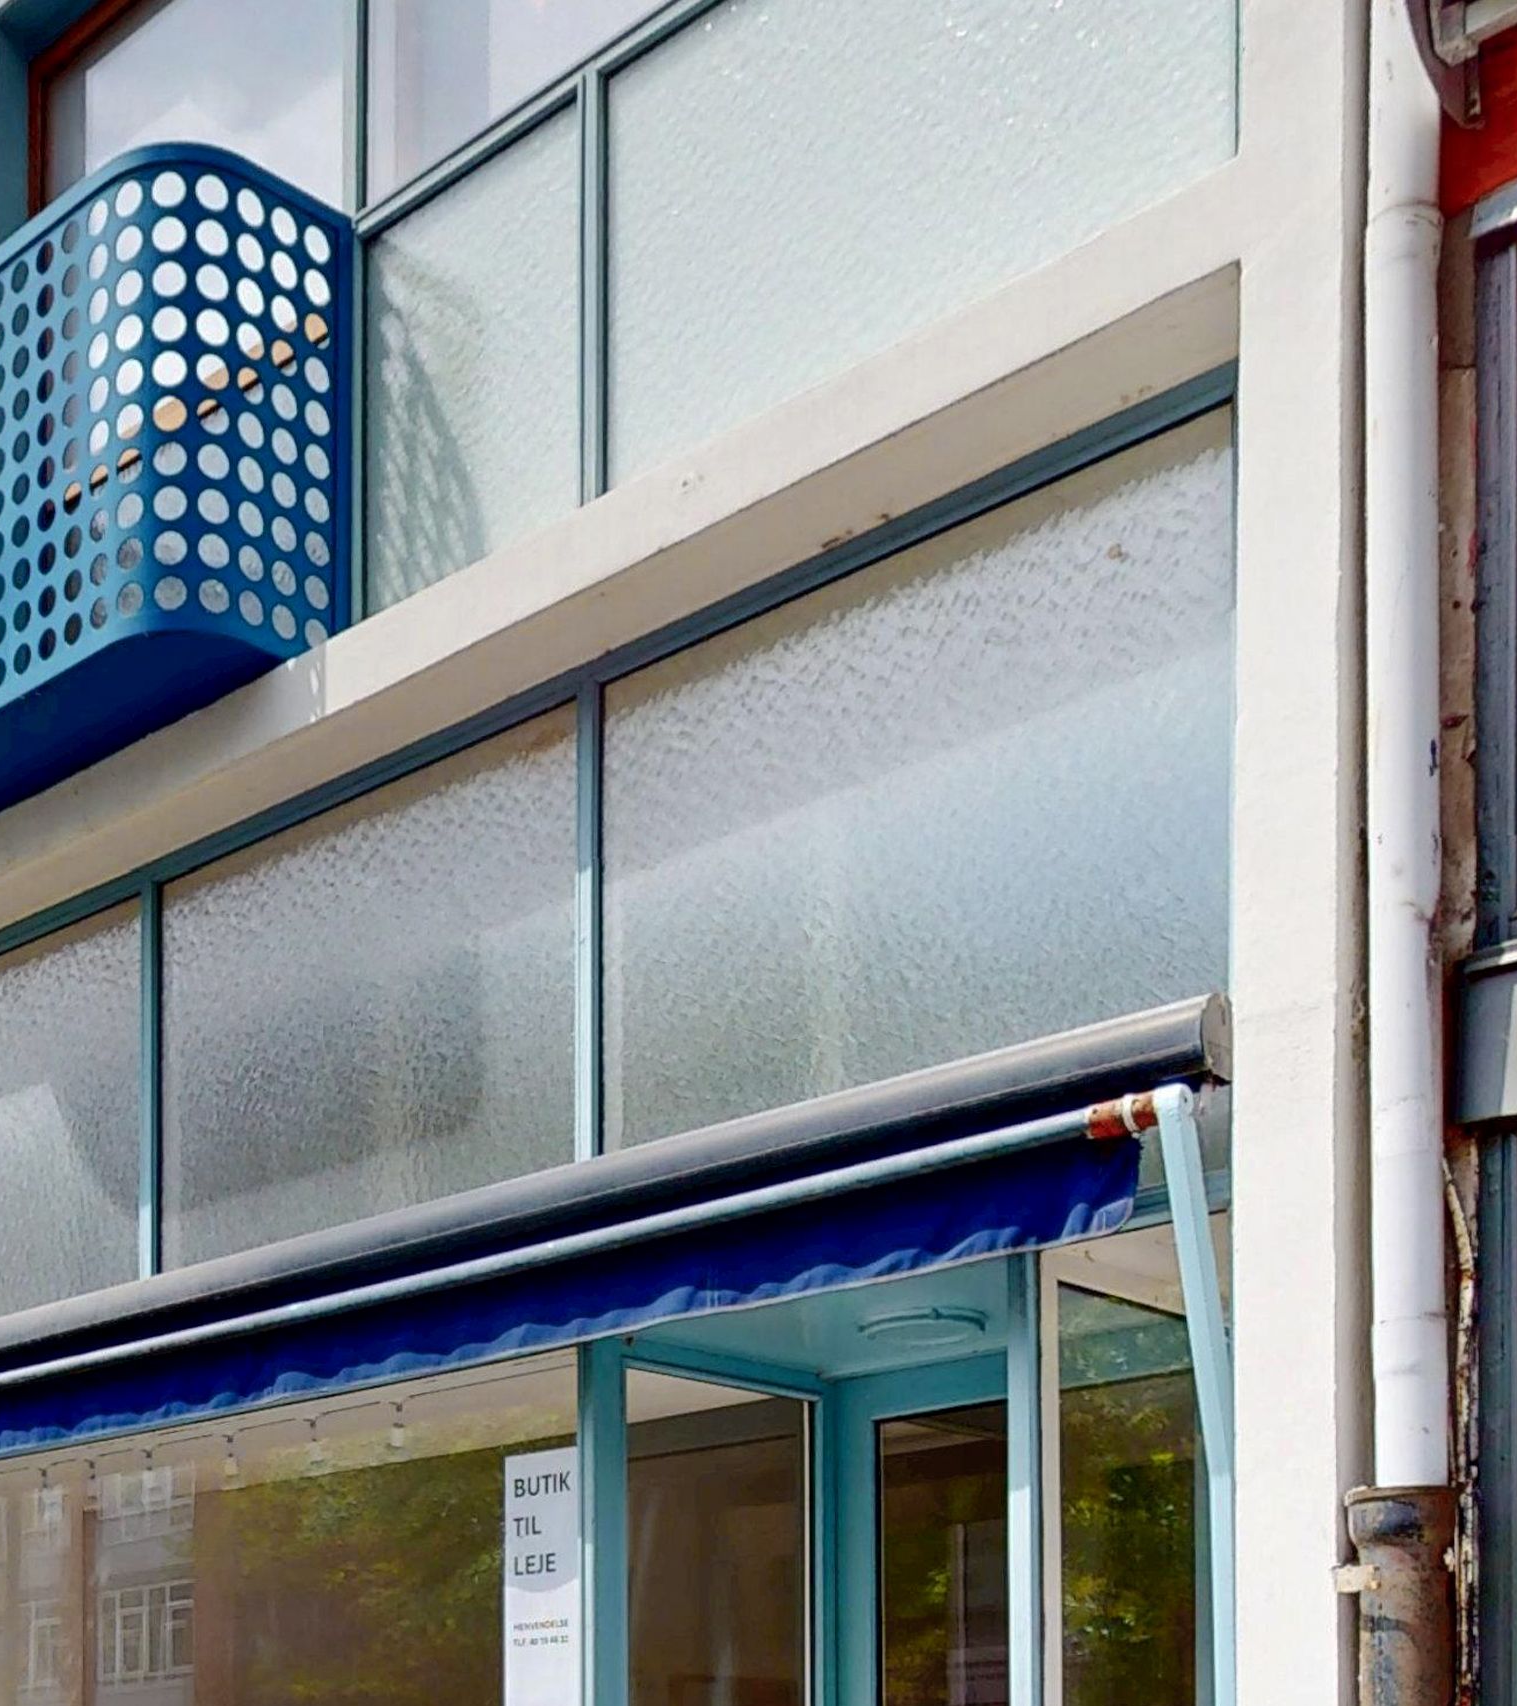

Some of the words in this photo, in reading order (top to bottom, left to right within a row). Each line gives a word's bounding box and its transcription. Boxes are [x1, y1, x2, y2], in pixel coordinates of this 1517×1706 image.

[514, 1470, 571, 1498] BUTIK
[513, 1515, 542, 1537] TIL
[514, 1553, 557, 1576] LEJE
